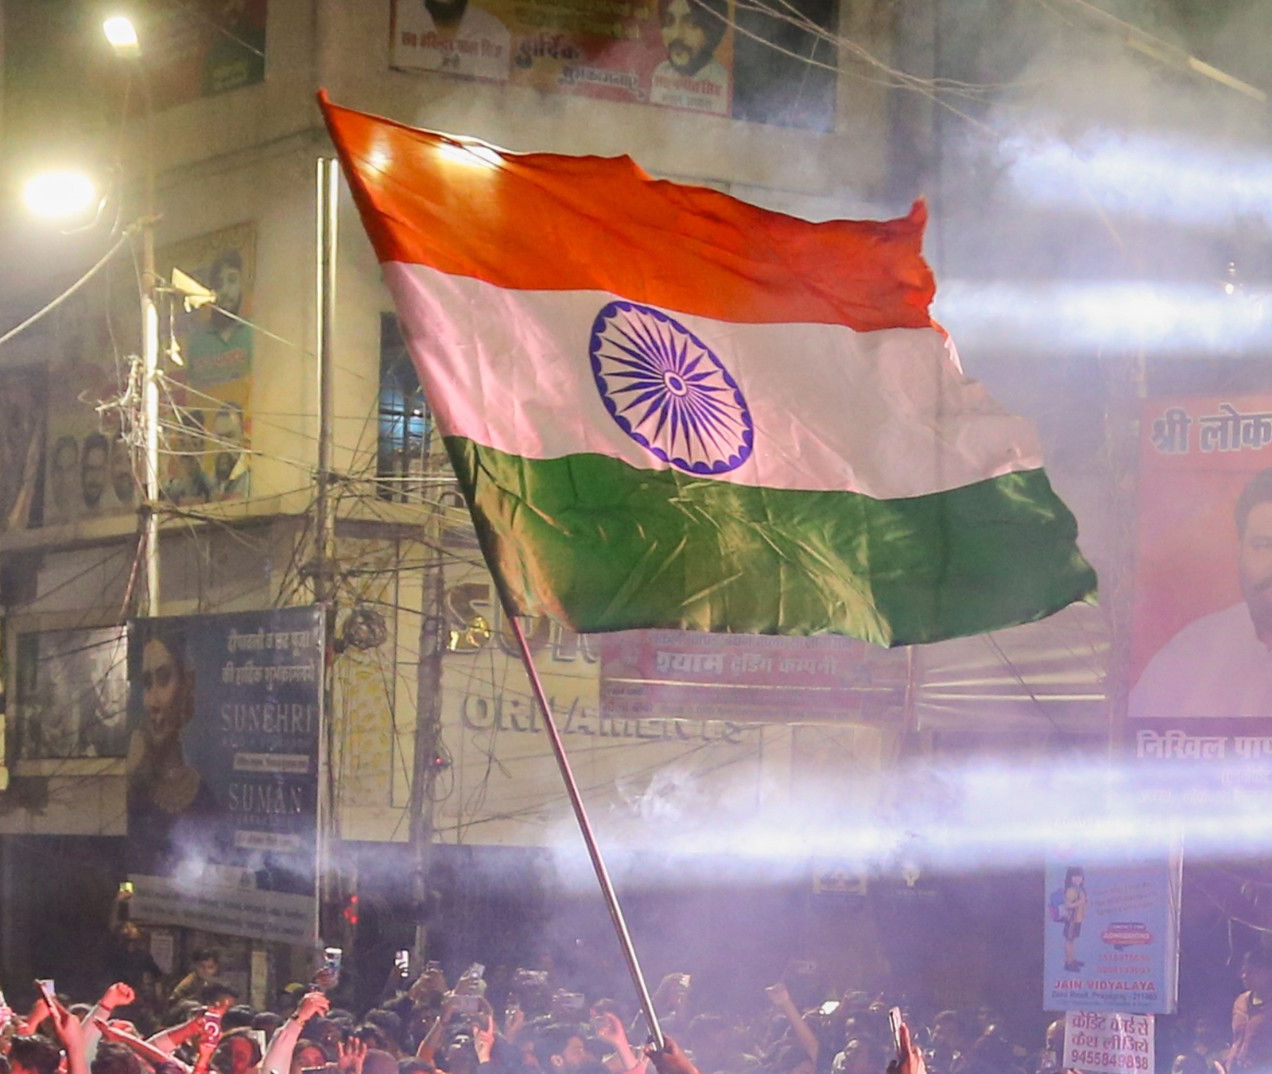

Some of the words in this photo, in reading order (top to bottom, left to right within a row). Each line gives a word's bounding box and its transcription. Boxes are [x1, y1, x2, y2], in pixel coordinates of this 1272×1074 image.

[1148, 402, 1190, 455] श्री
[656, 650, 726, 674] श्याम
[220, 703, 313, 733] SUNEHRI
[1136, 729, 1228, 759] निखिल
[229, 782, 302, 813] SUMAN
[1054, 979, 1082, 991] JAIN
[1087, 979, 1157, 992] VIDYALAYA
[1071, 1031, 1098, 1048] कैश
